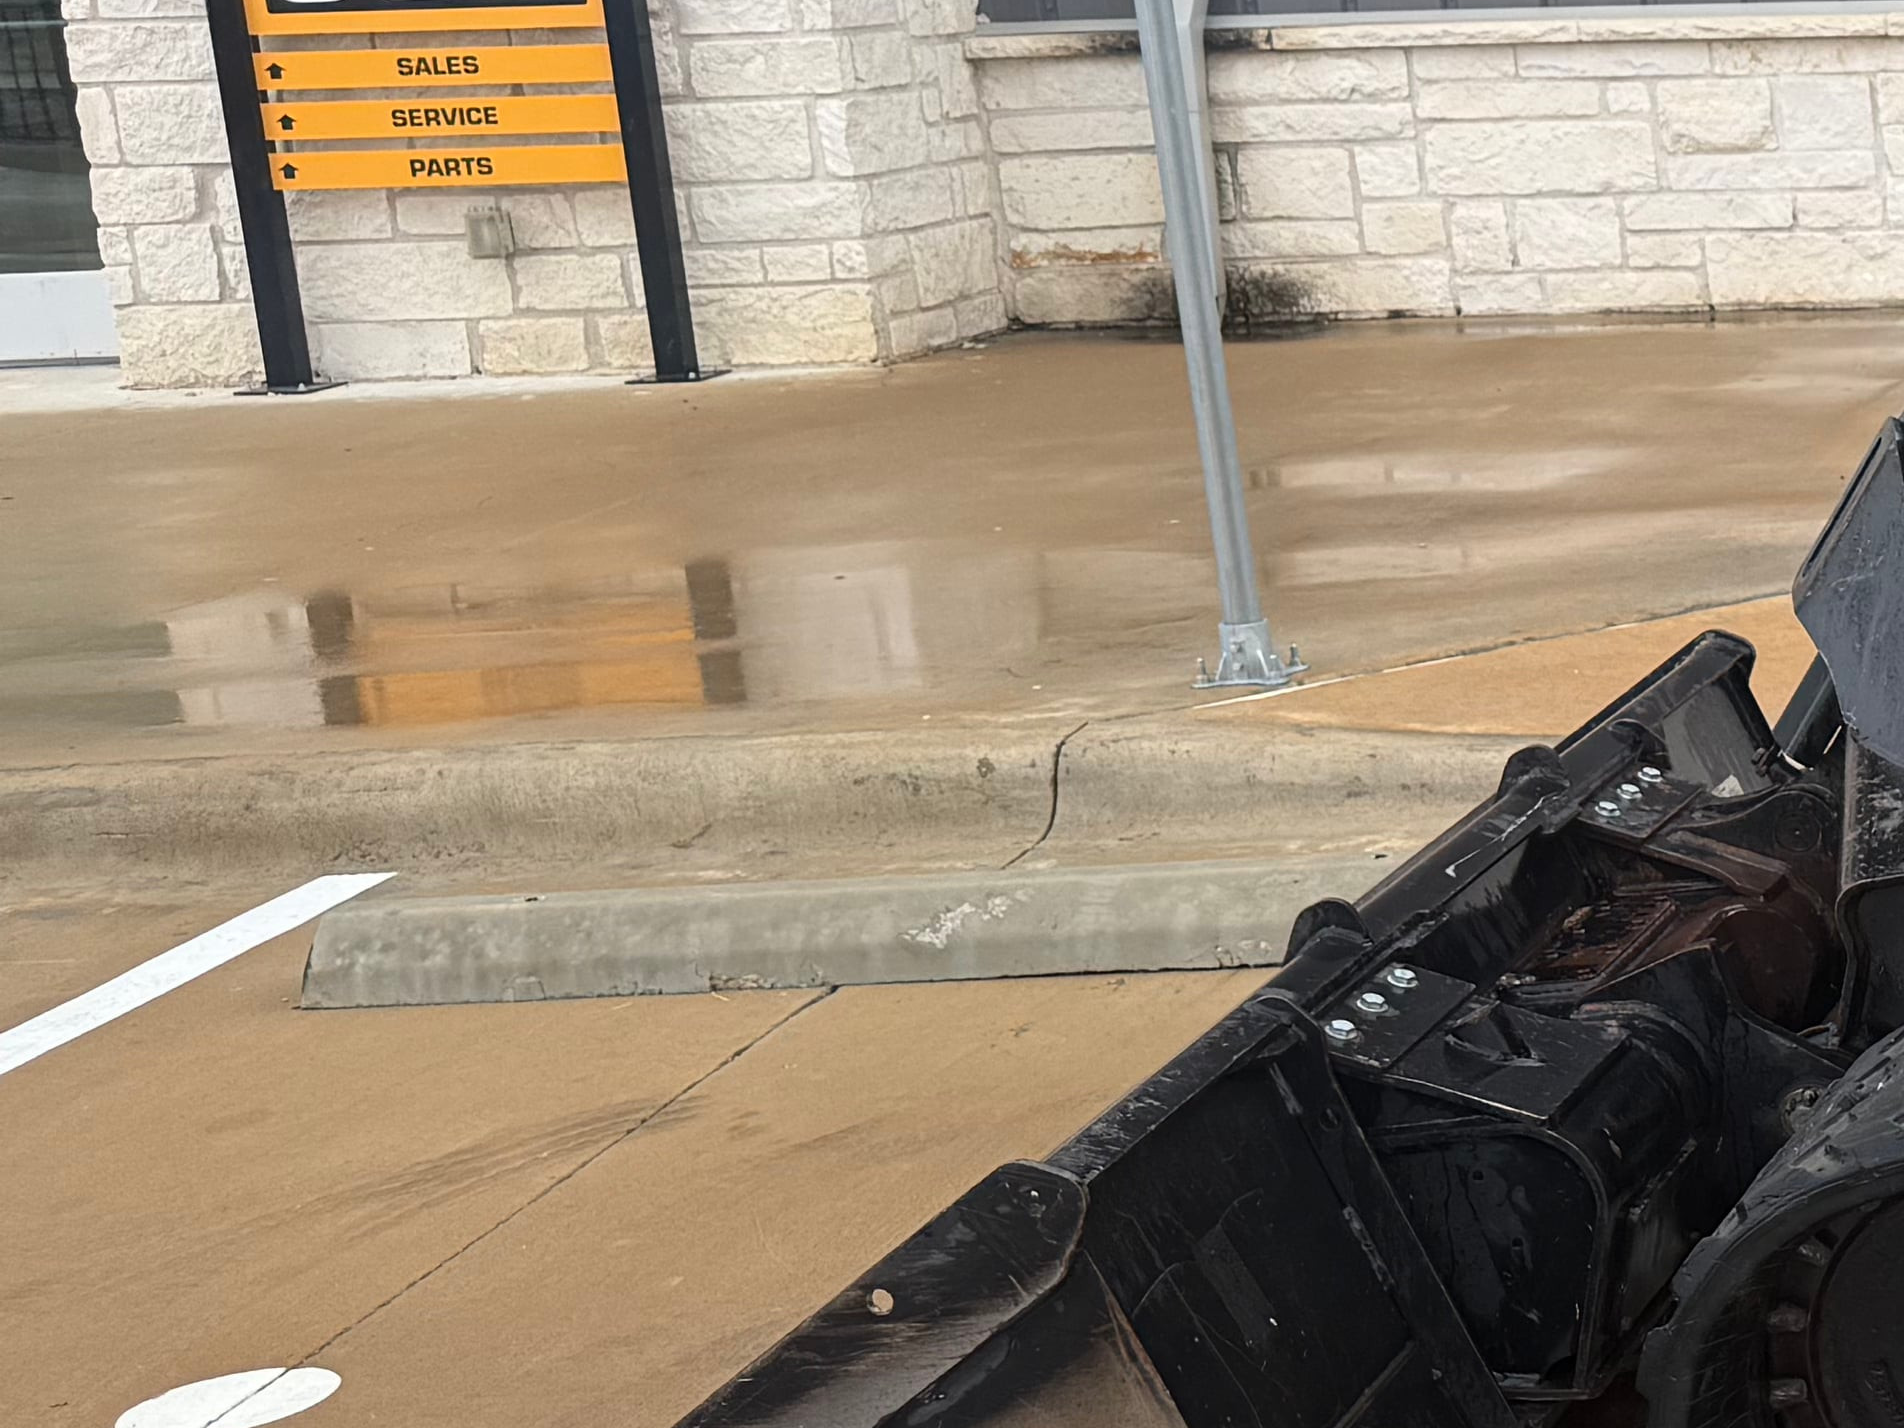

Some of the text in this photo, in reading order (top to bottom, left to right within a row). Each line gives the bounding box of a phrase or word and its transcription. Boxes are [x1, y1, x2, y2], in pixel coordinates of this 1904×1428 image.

[396, 56, 480, 77] SALES
[391, 107, 499, 128] SERVICE
[410, 157, 494, 178] PARTS
